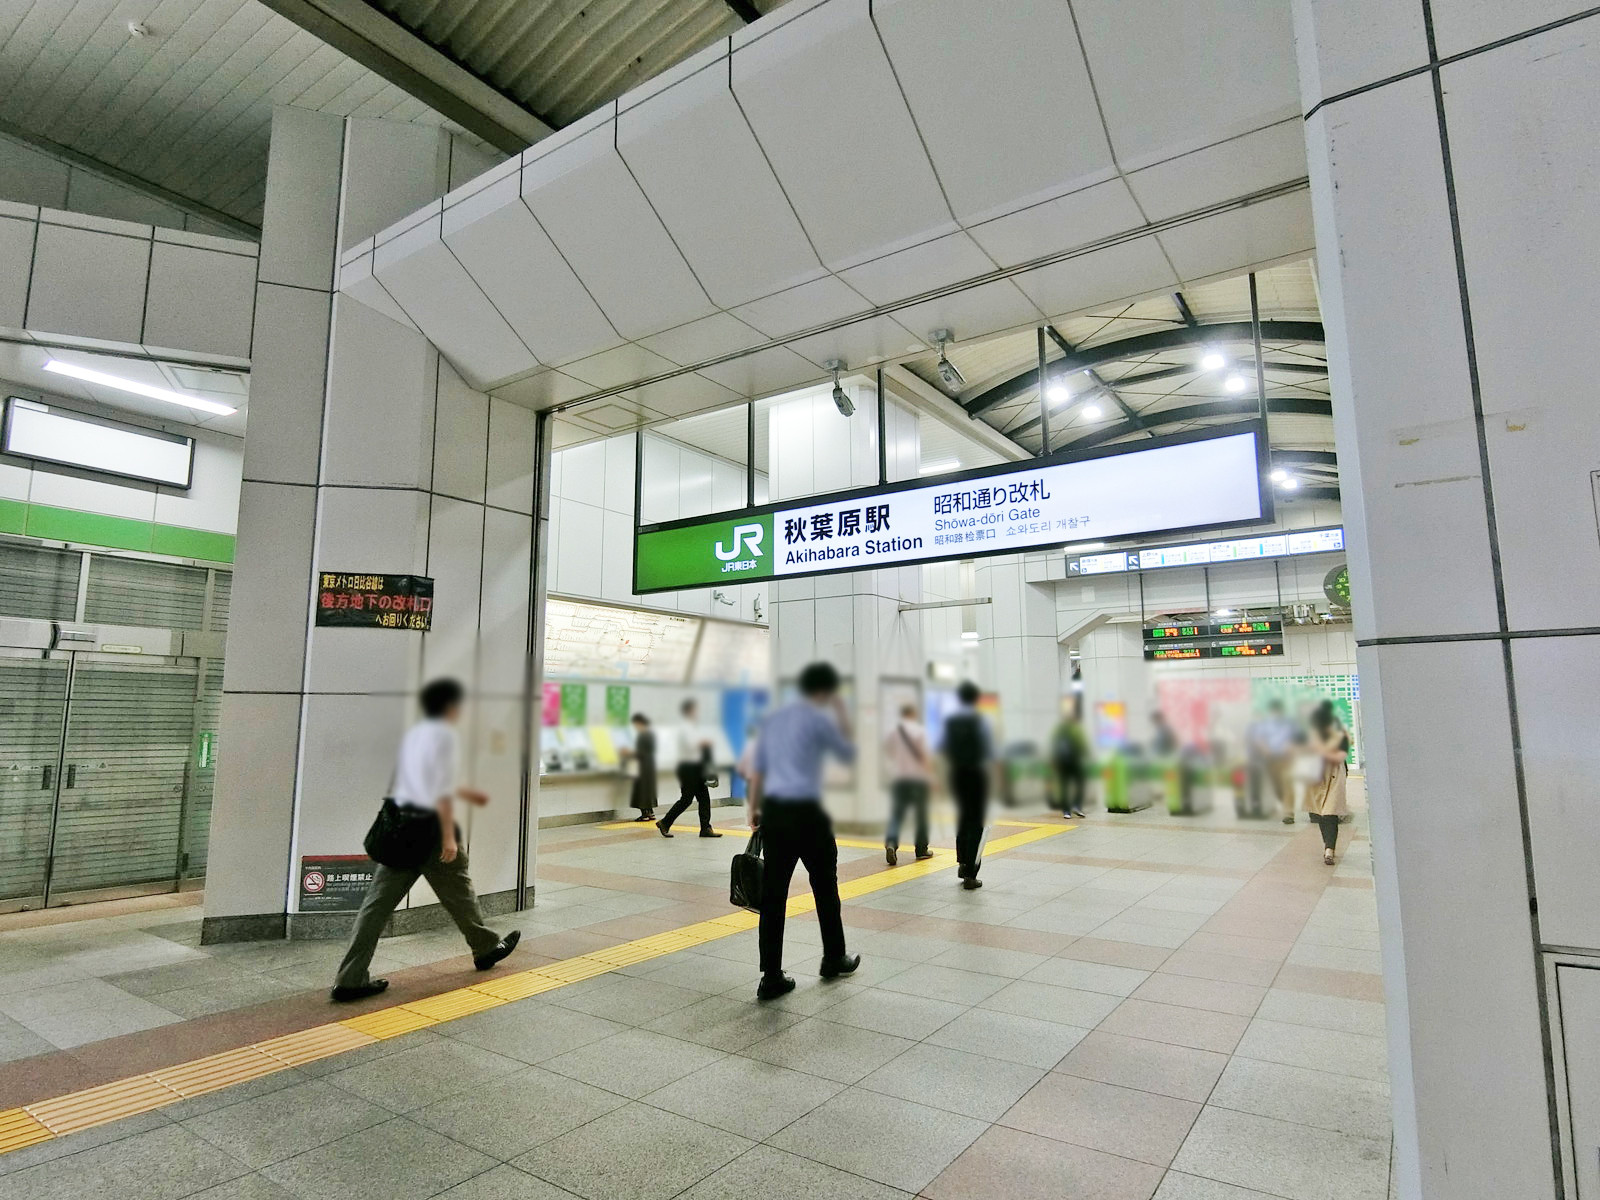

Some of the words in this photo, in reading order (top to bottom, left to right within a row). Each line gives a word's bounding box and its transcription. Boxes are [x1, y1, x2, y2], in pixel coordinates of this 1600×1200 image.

[934, 479, 1050, 515] 昭和通り改札
[784, 504, 891, 545] 秋葉原駅
[935, 511, 1004, 531] Shōwa-dōri
[1008, 507, 1041, 520] Gate
[1005, 521, 1051, 537] 쇼와도리
[1056, 516, 1091, 530] 개찰구
[715, 523, 764, 561] JR
[934, 529, 996, 545] 昭和路检票口
[785, 544, 860, 565] Akihabara
[865, 535, 923, 554] Station
[721, 559, 757, 573] JR東日本
[321, 593, 432, 611] 後方地下の改札口
